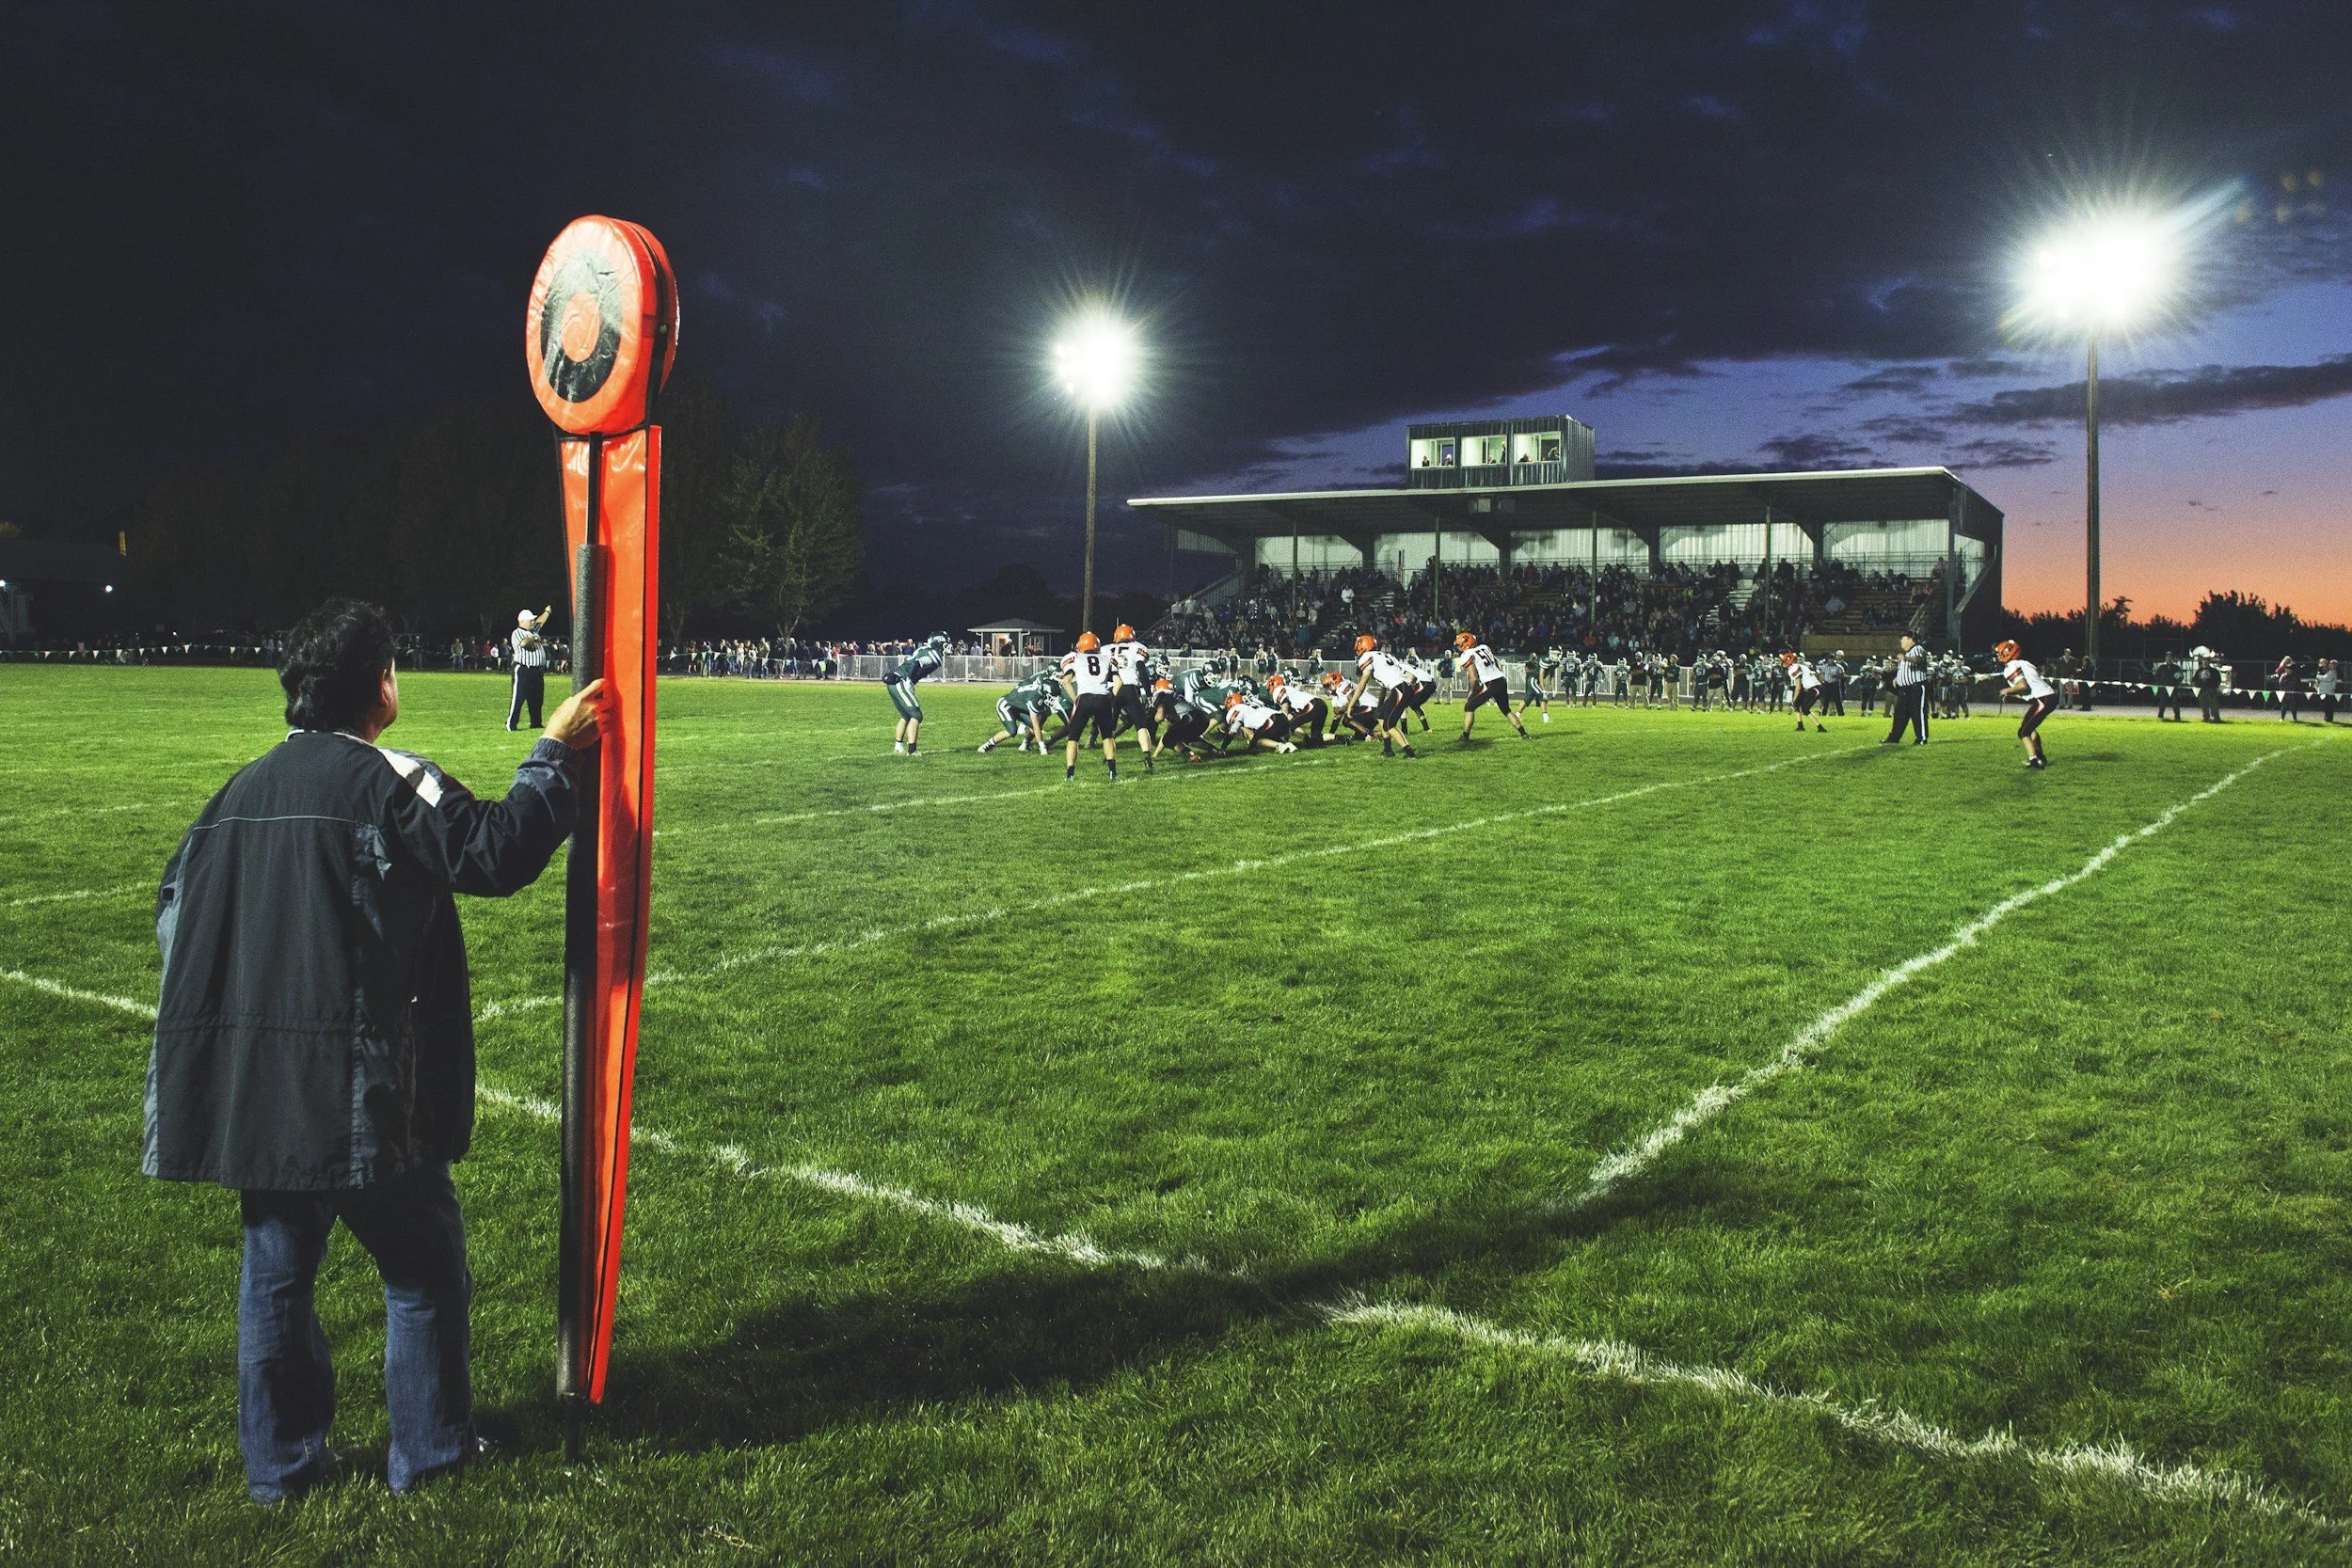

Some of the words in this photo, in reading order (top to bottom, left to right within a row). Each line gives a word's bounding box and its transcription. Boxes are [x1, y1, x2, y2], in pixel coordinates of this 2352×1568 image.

[1087, 656, 1101, 676] 8
[1566, 662, 1575, 673] 12
[1589, 666, 1595, 675] 4
